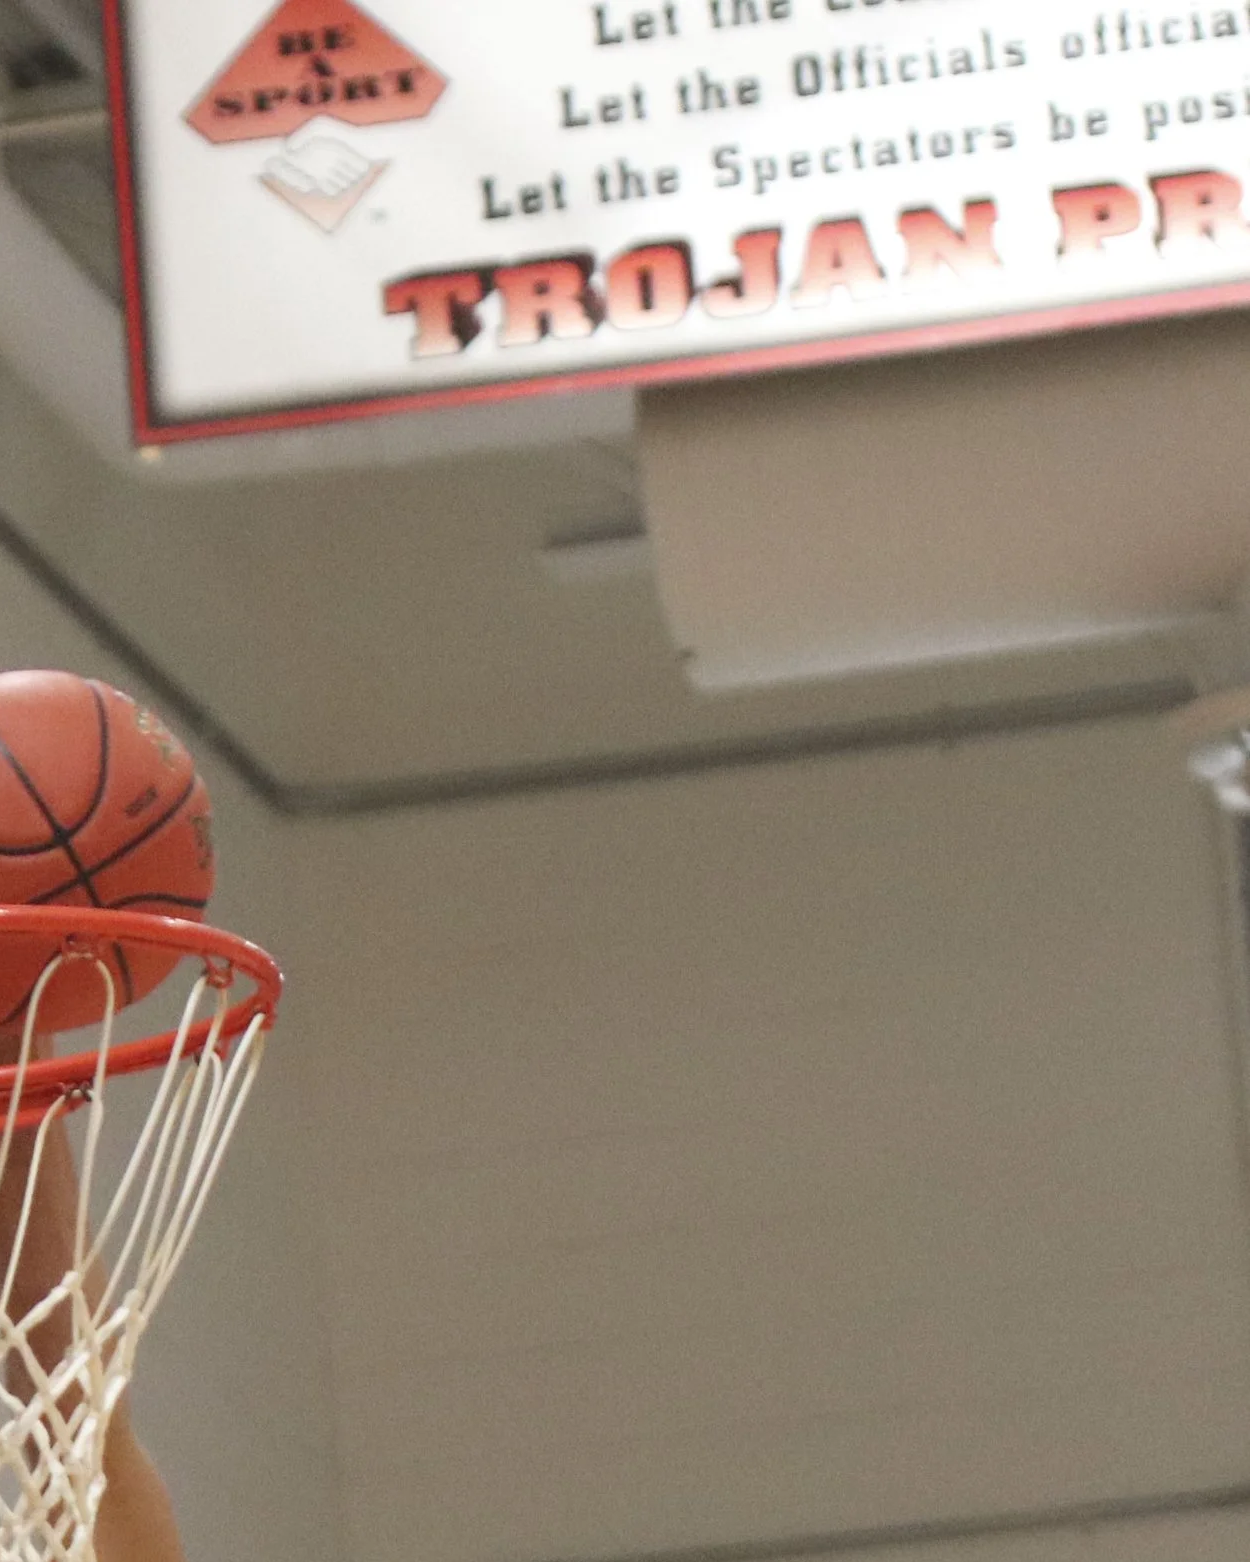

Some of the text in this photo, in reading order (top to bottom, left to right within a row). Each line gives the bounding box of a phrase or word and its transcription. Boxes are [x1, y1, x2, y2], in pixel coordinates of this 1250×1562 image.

[278, 22, 354, 56] BE
[593, 1, 679, 46] Let
[213, 67, 424, 116] SPORT
[558, 83, 648, 129] Let
[676, 66, 762, 114] the
[792, 28, 1028, 97] Officials
[480, 171, 567, 220] Let
[596, 155, 680, 203] the
[711, 121, 1017, 196] Spectators
[1048, 100, 1110, 142] be
[381, 195, 1003, 360] TROJAN
